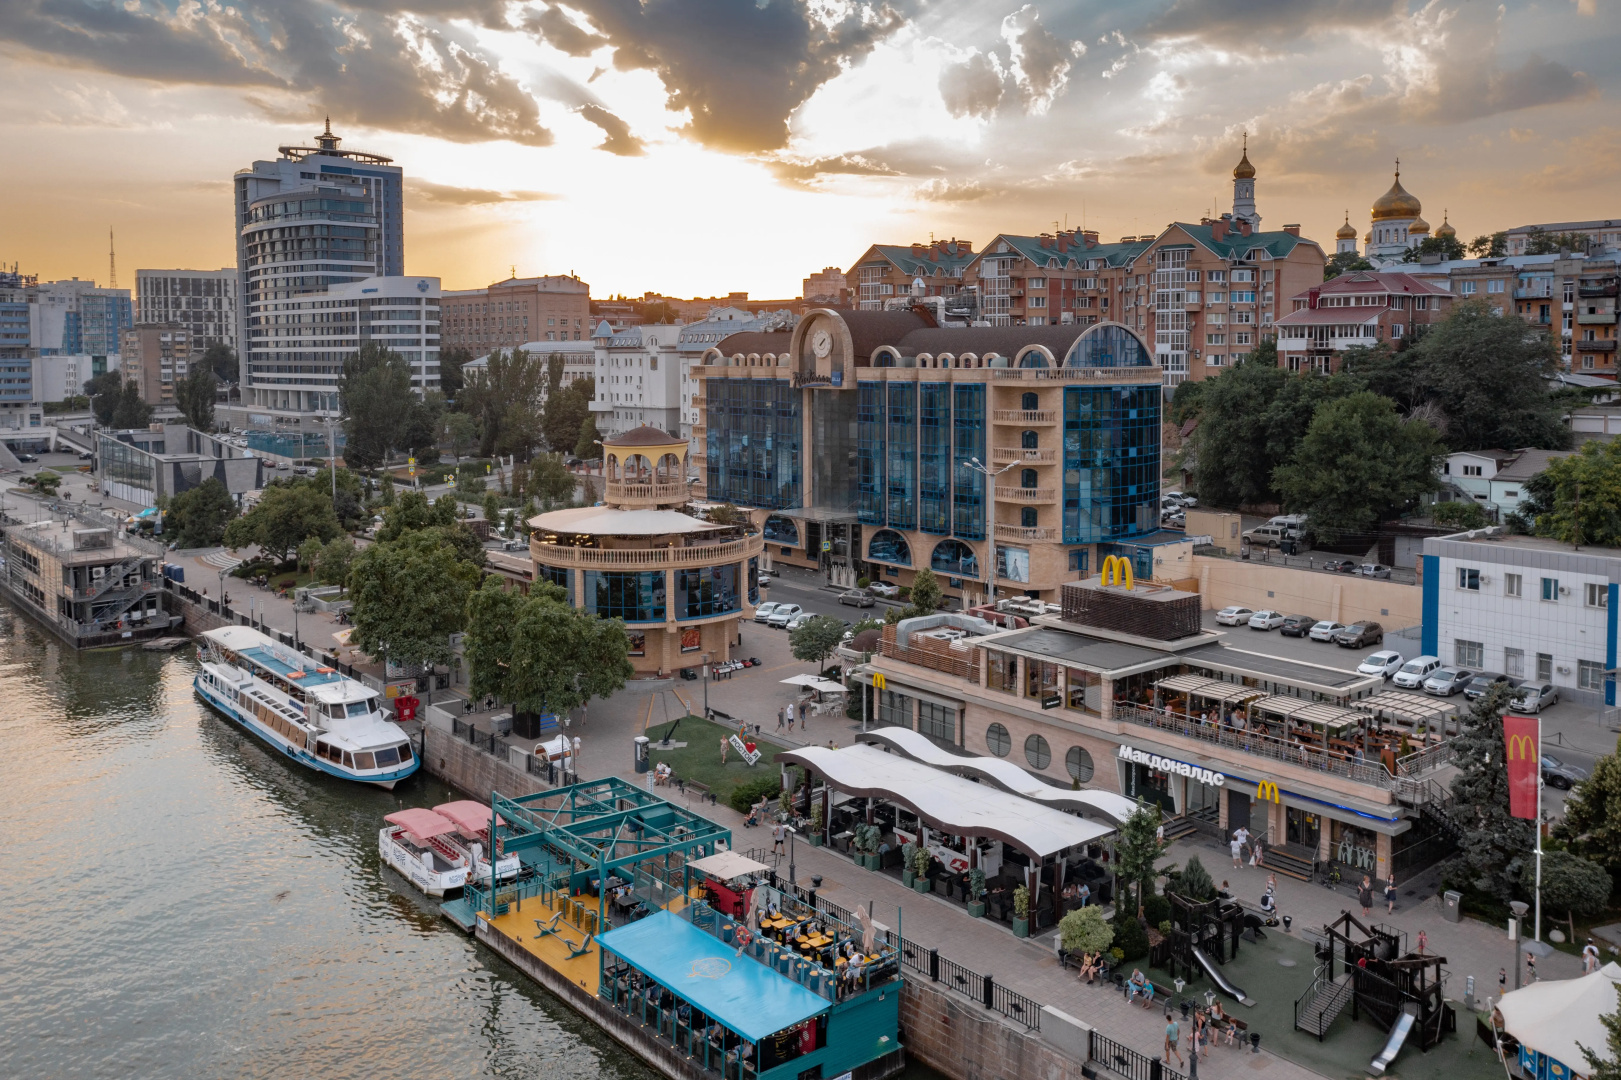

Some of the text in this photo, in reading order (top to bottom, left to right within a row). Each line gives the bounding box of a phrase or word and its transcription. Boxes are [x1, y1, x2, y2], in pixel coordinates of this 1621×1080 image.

[731, 738, 754, 763] РОСТОВ
[752, 752, 759, 760] Я
[1118, 744, 1225, 787] Макдоналдс
